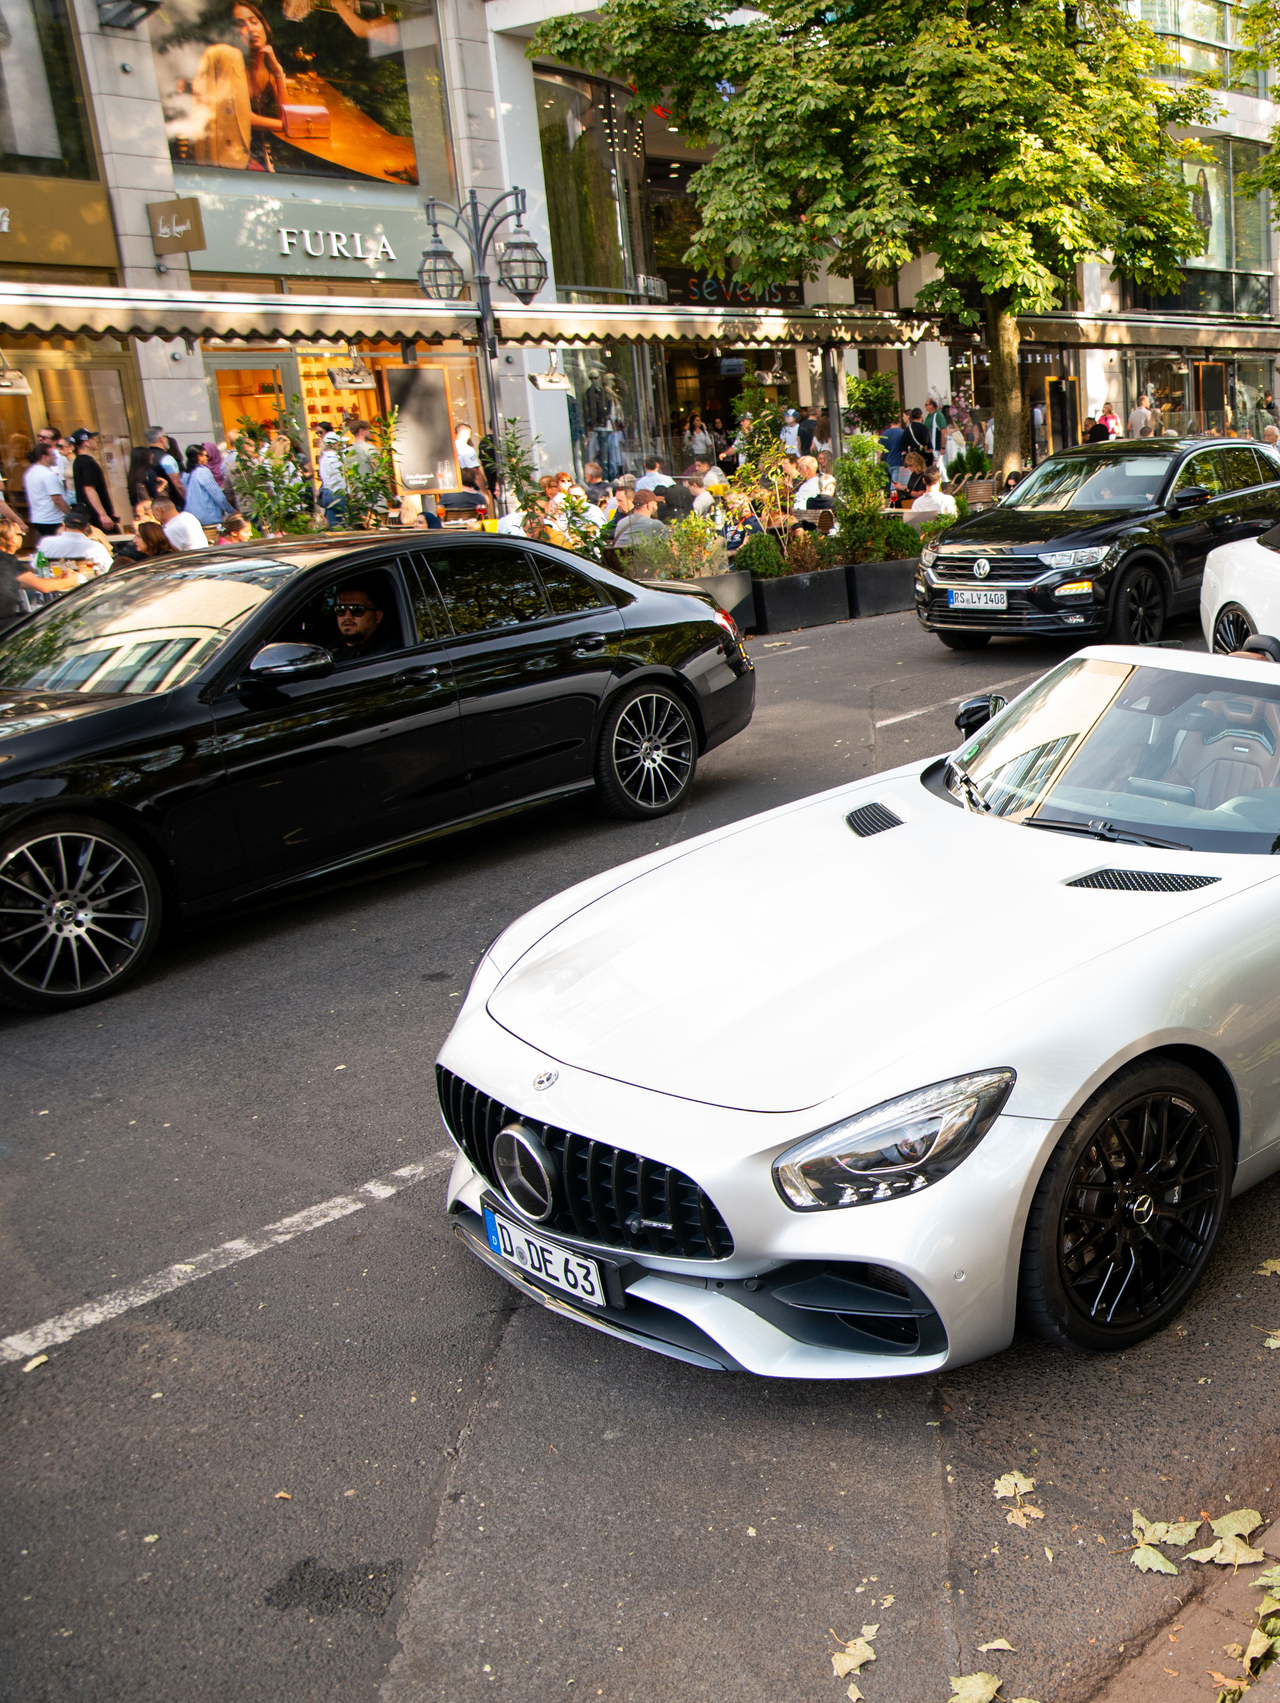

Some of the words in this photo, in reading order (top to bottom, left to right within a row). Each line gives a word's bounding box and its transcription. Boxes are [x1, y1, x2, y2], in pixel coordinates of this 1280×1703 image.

[278, 228, 397, 260] FURLA
[954, 592, 965, 604] RS
[971, 592, 982, 604] LY
[984, 592, 1005, 605] 1408
[492, 1235, 498, 1246] D
[498, 1222, 515, 1258] D
[524, 1237, 560, 1283] DE
[563, 1257, 596, 1297] 63
